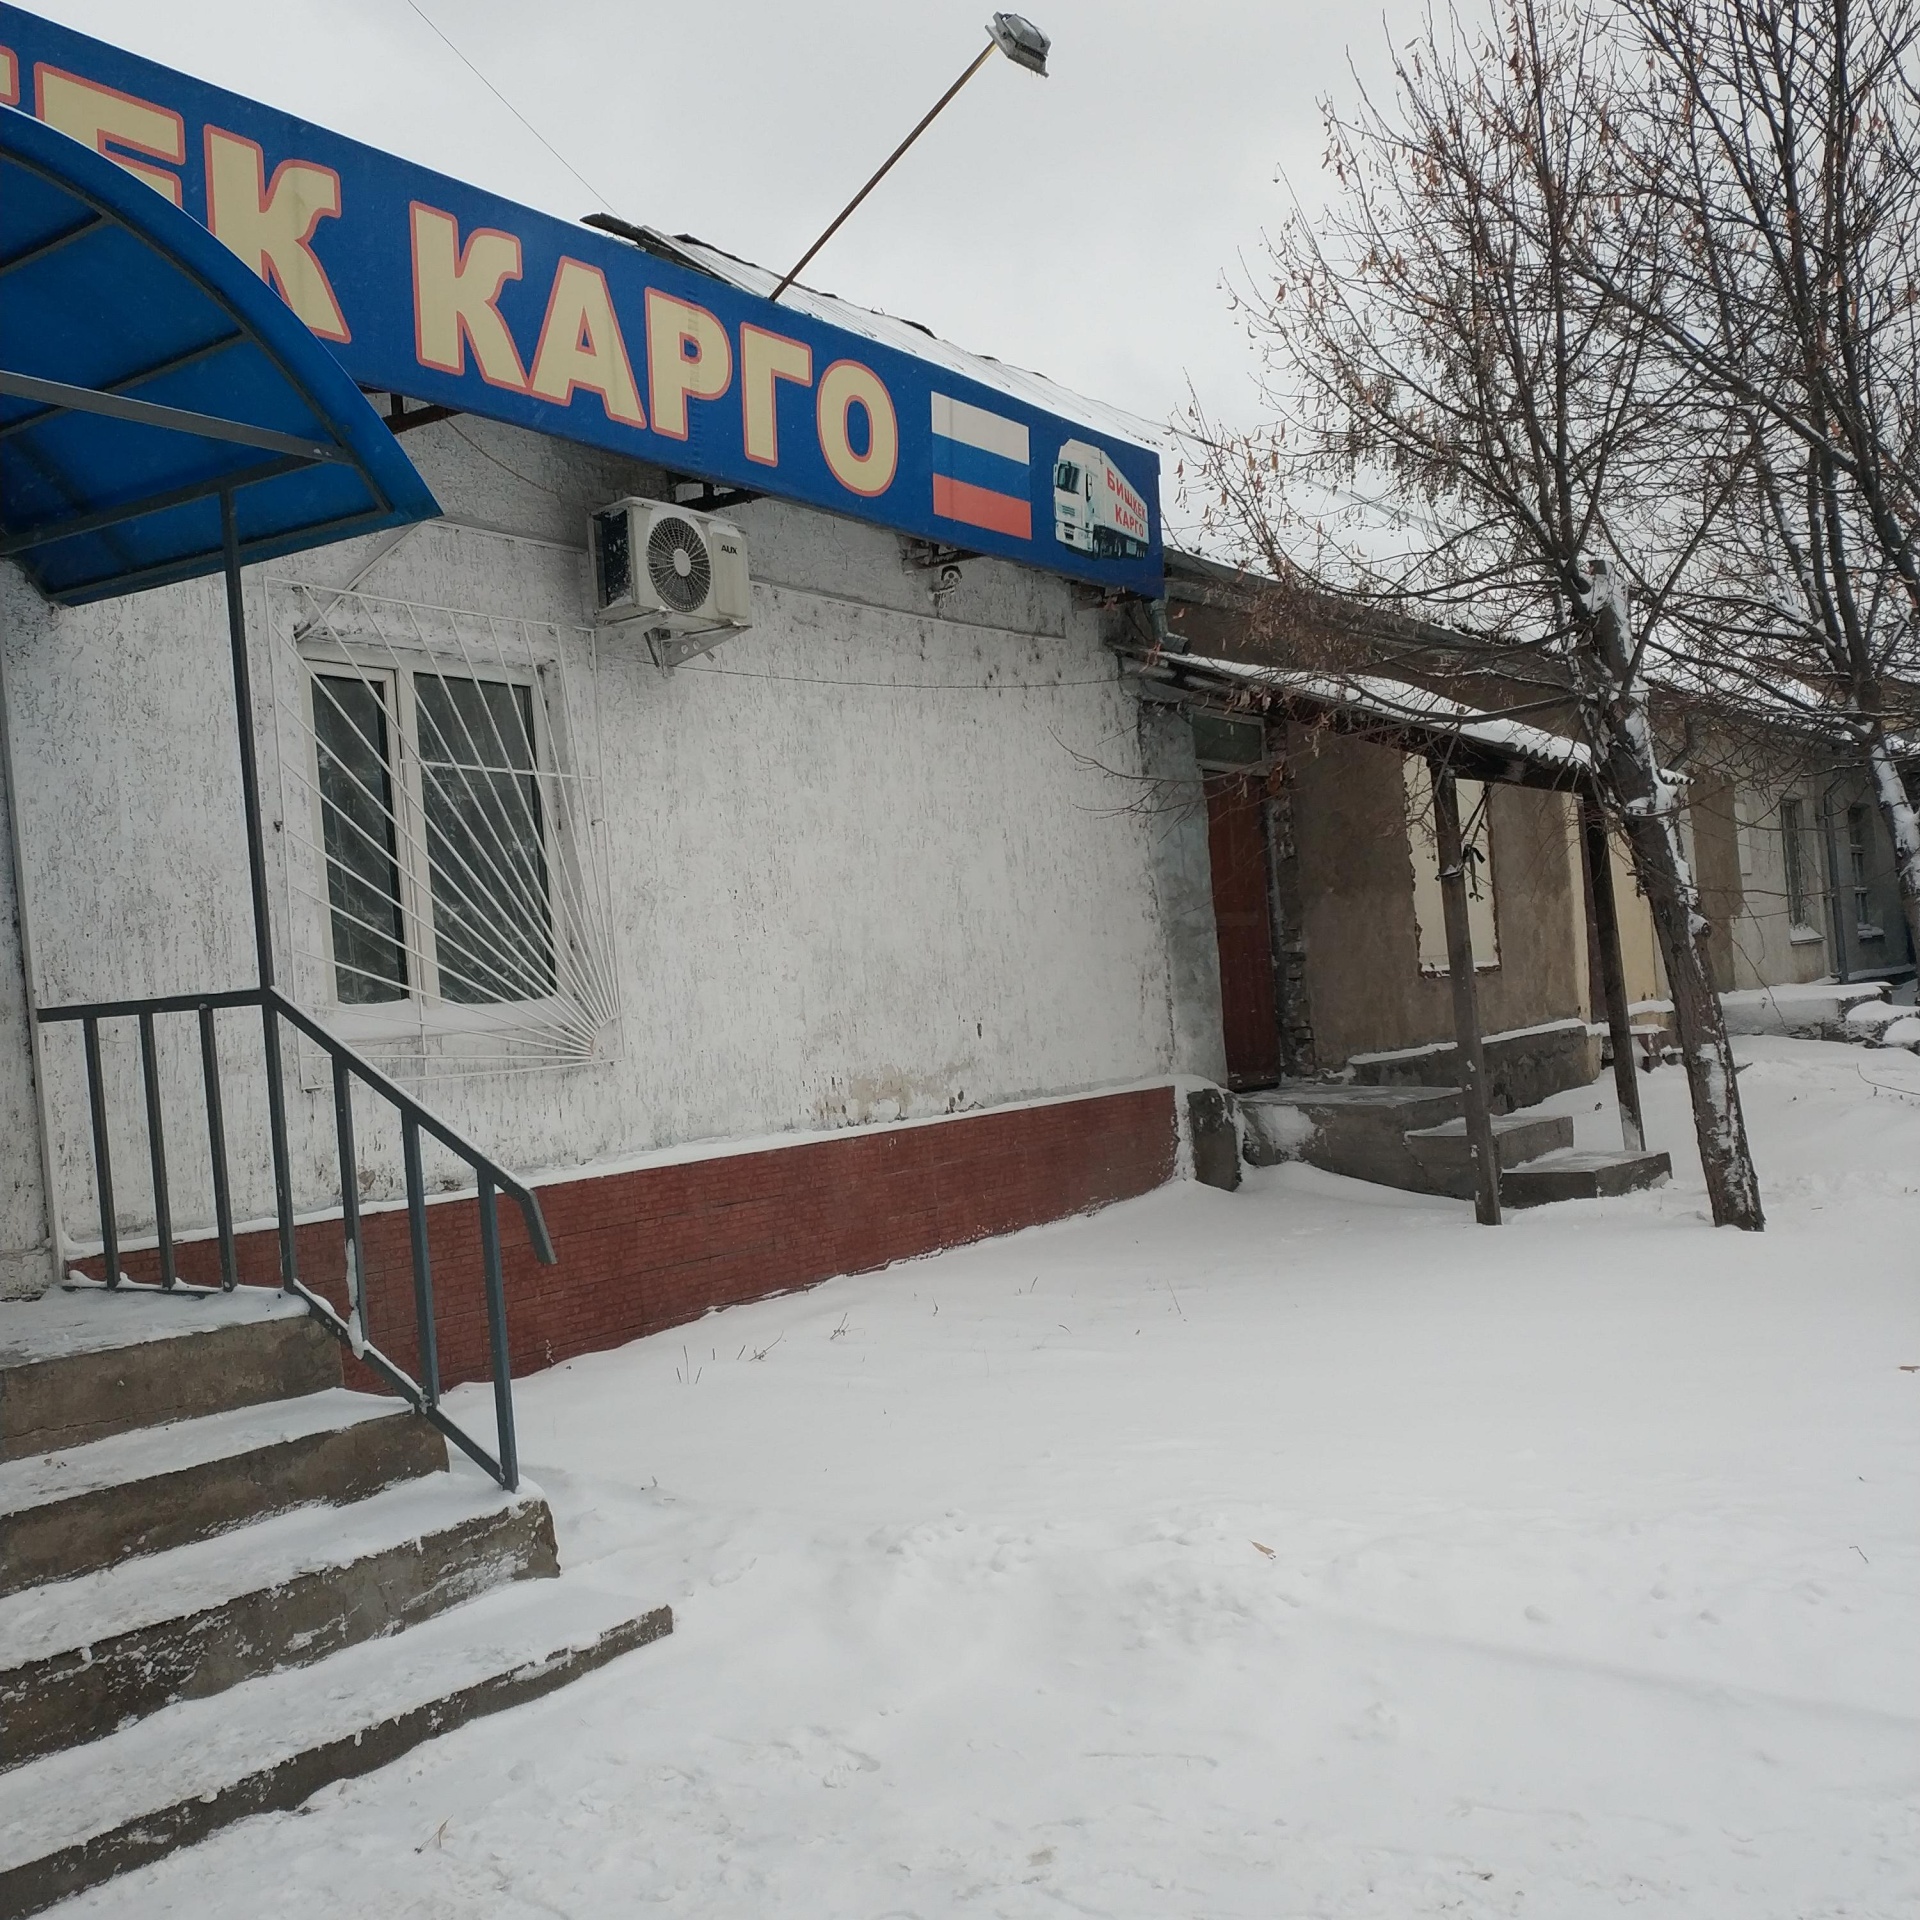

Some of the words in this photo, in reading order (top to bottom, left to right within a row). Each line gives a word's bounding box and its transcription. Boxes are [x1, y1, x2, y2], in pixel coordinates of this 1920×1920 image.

[409, 201, 898, 497] КАРГО
[1106, 467, 1146, 520] БИШКЕК
[1115, 503, 1144, 538] КАРГО
[721, 544, 738, 555] AUX
